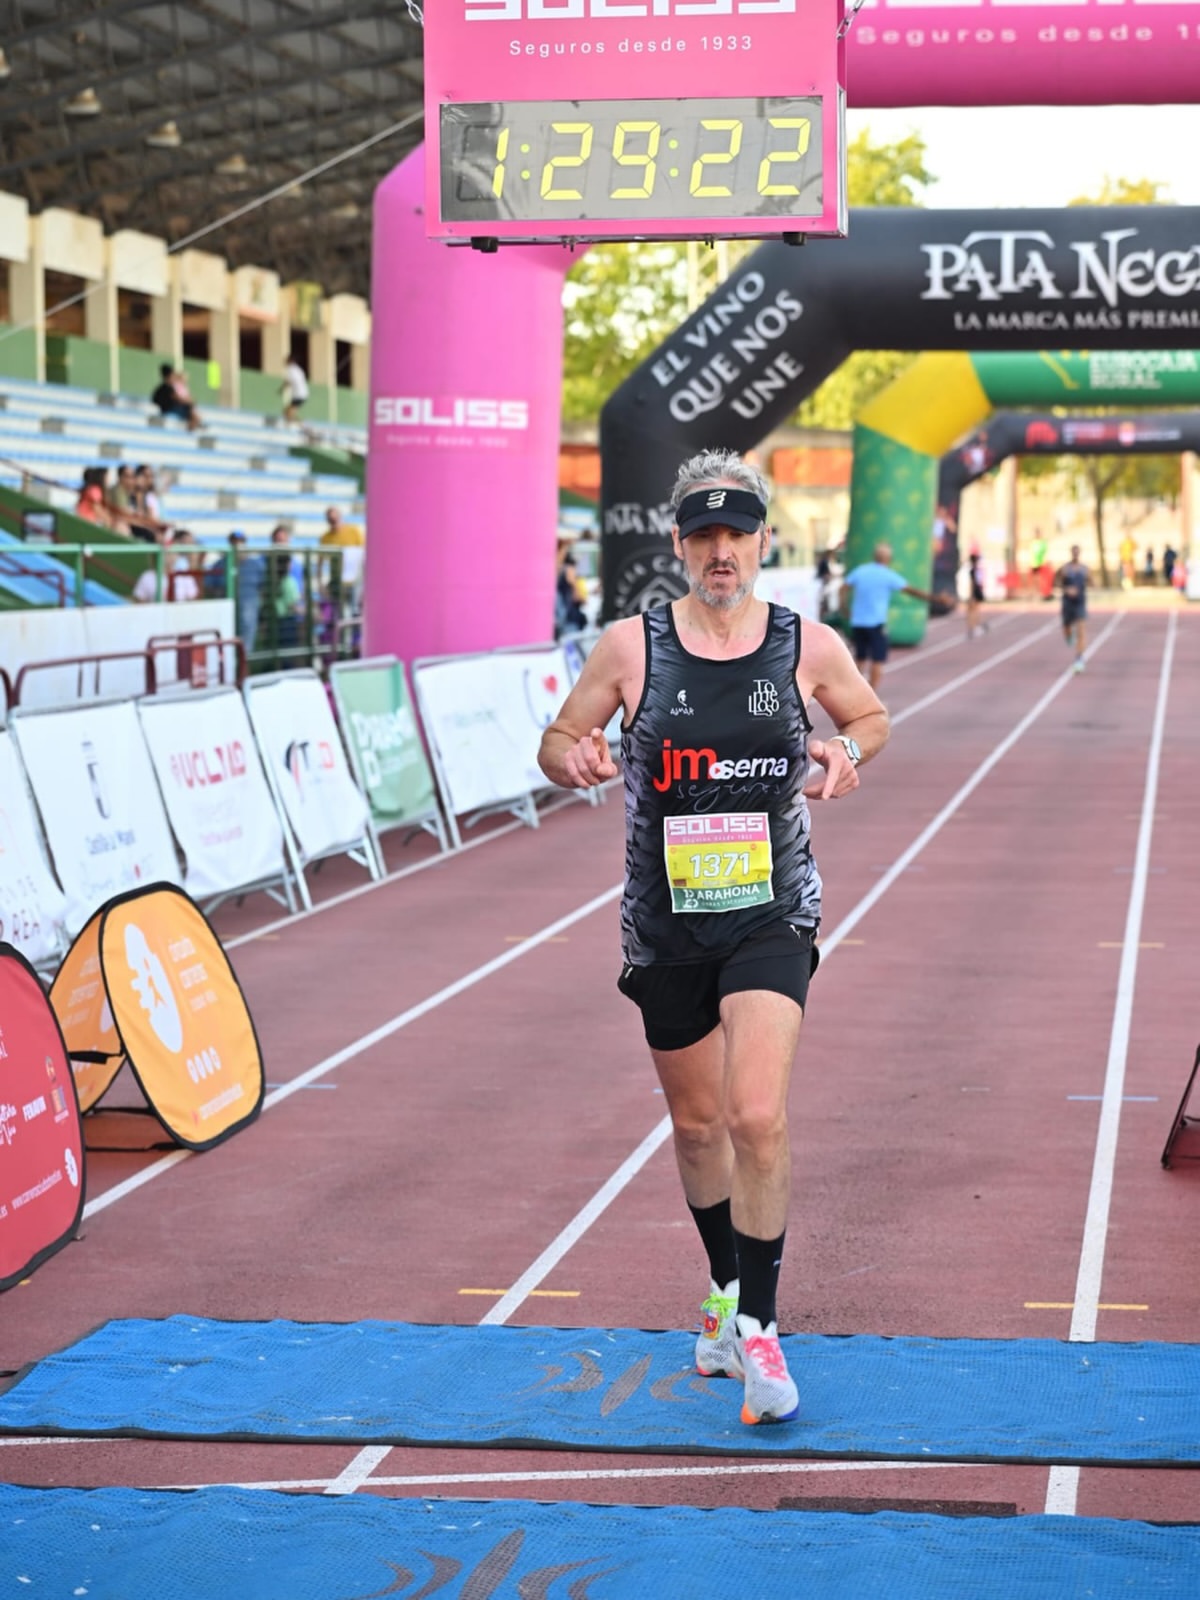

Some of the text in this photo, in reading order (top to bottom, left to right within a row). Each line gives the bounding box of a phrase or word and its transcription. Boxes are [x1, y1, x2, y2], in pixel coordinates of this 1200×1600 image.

[509, 35, 753, 58] Seguros desde 1933
[856, 26, 1017, 46] Seguros
[1038, 24, 1152, 42] desde
[492, 118, 811, 200] 1:29:22
[920, 228, 1200, 308] PATA NEG
[651, 271, 765, 387] EL VINO
[954, 312, 981, 330] LA
[986, 312, 1070, 330] MARCA
[1073, 307, 1121, 330] MÁS
[669, 289, 803, 422] QUE NOS
[730, 351, 804, 419] UNE
[374, 397, 529, 430] SOLISS
[668, 817, 764, 836] SOLISS
[689, 851, 751, 879] 1371
